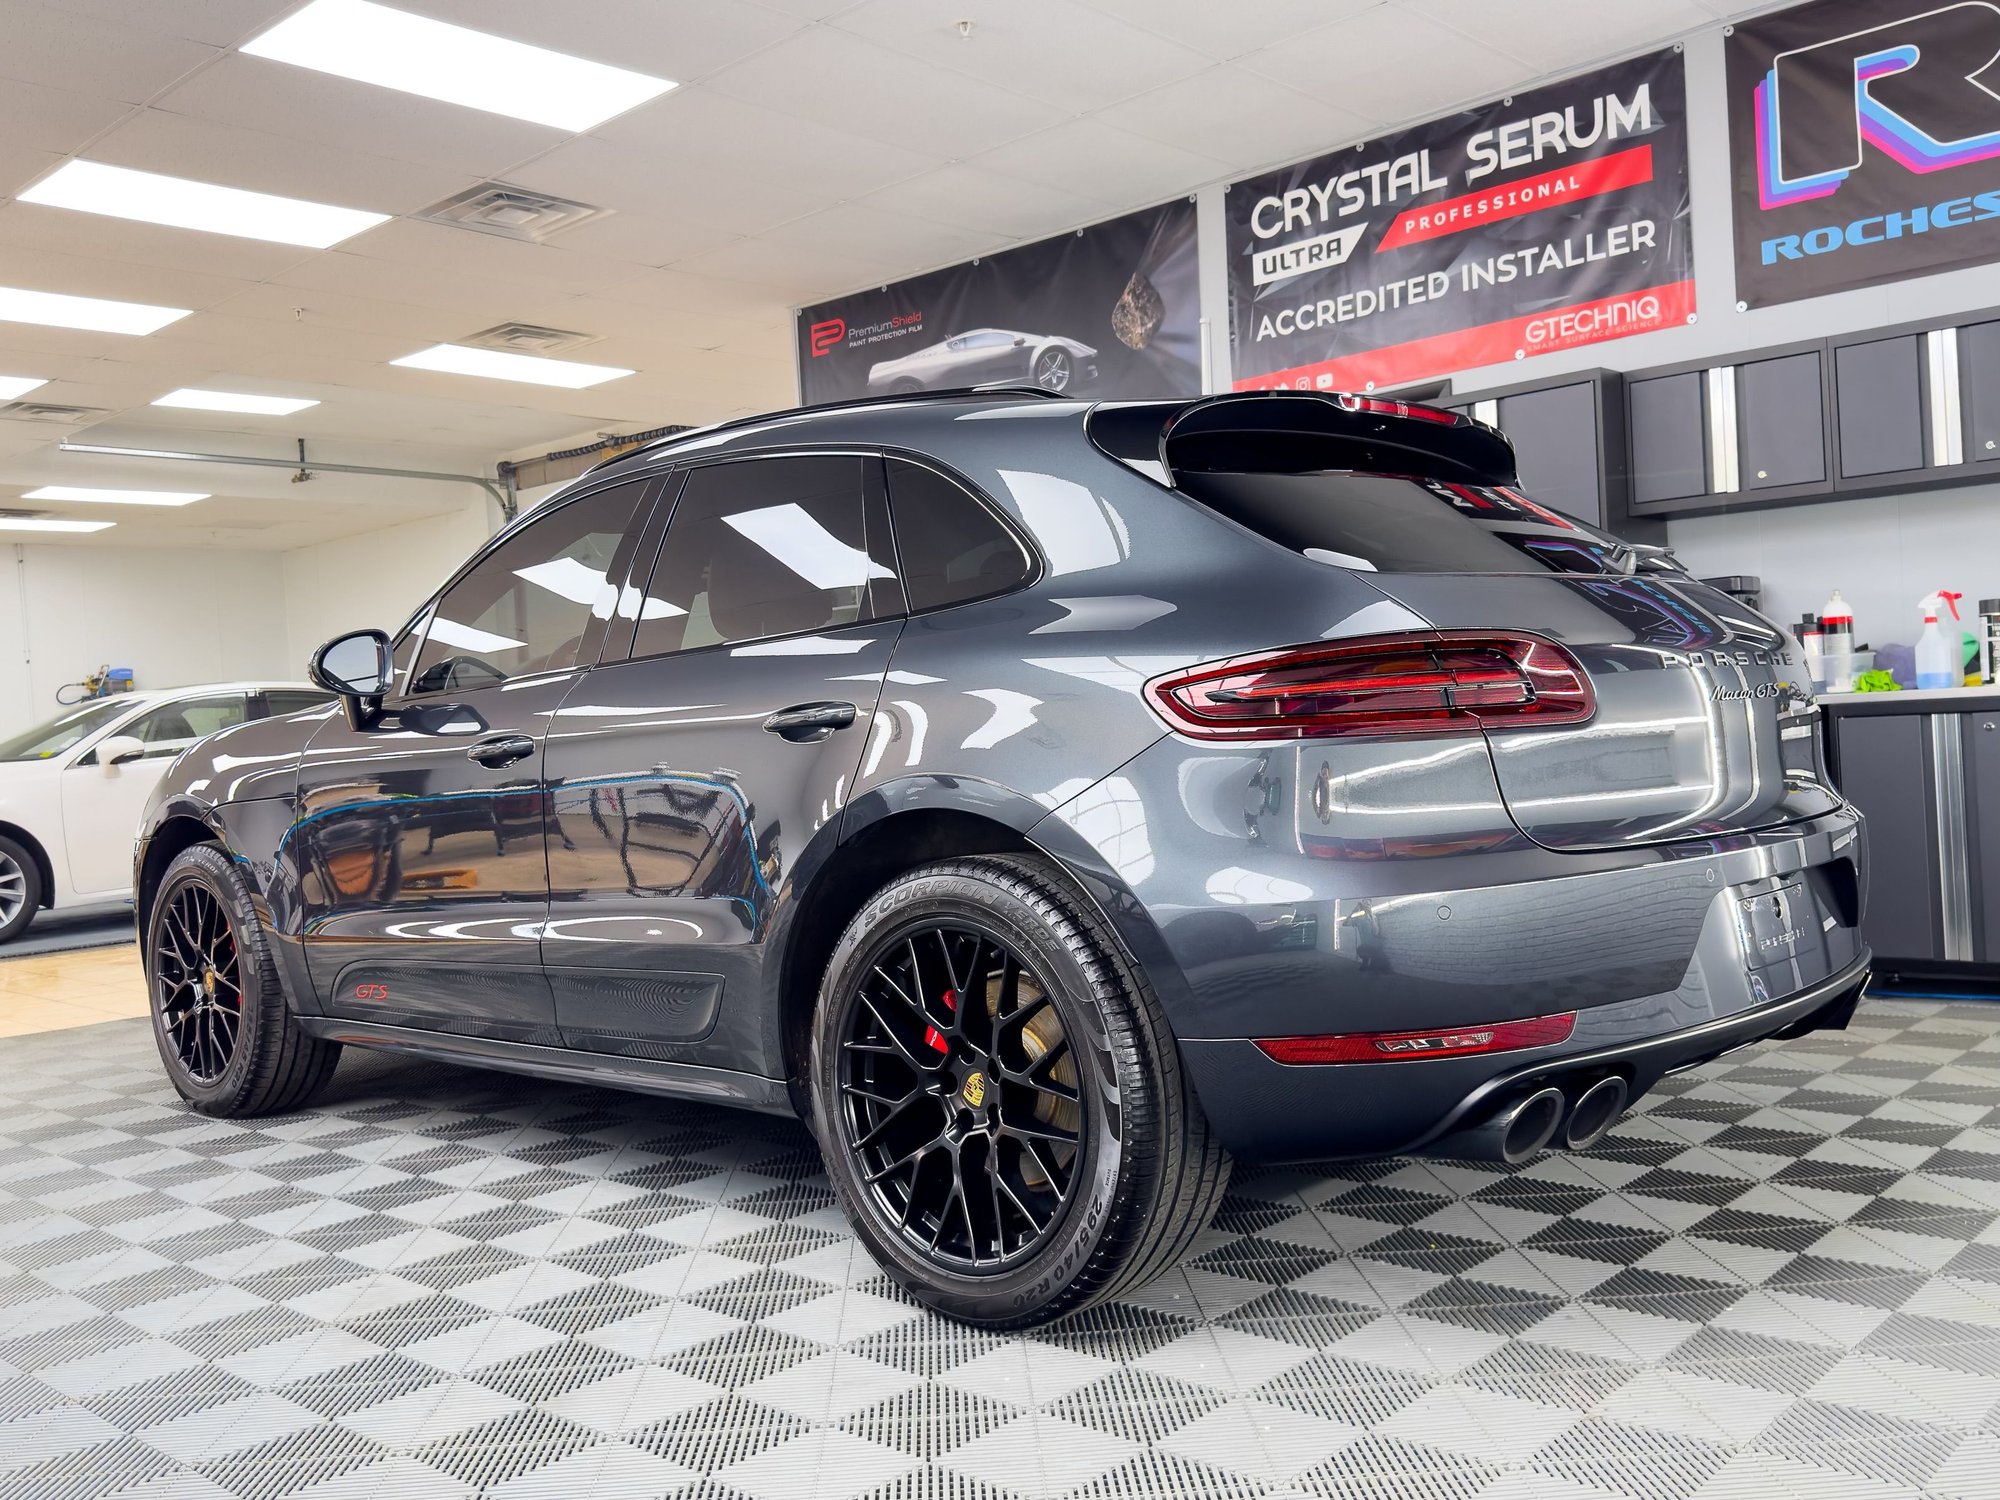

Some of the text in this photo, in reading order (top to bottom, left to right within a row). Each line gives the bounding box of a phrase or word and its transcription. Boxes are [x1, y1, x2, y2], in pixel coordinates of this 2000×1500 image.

[1250, 83, 1651, 239] CRYSTAL SERUM
[1405, 176, 1580, 234] PROFESSIONAL
[1262, 237, 1342, 275] ULTRA
[1256, 219, 1656, 342] ACCREDITED INSTALLER
[848, 311, 922, 339] PremiumShield
[849, 324, 923, 348] PAINT PROTECTION FILM
[1525, 296, 1659, 343] GTECHNIQ
[1527, 317, 1662, 352] SMART SURFACE SCIENCE
[1658, 651, 1794, 669] PORSCHE
[1711, 682, 1780, 701] Macan GTS
[864, 879, 1000, 928] SCORPION
[1004, 901, 1061, 952] VERDE
[355, 983, 389, 1000] GTS
[1013, 1194, 1103, 1308] 295/40 R20
